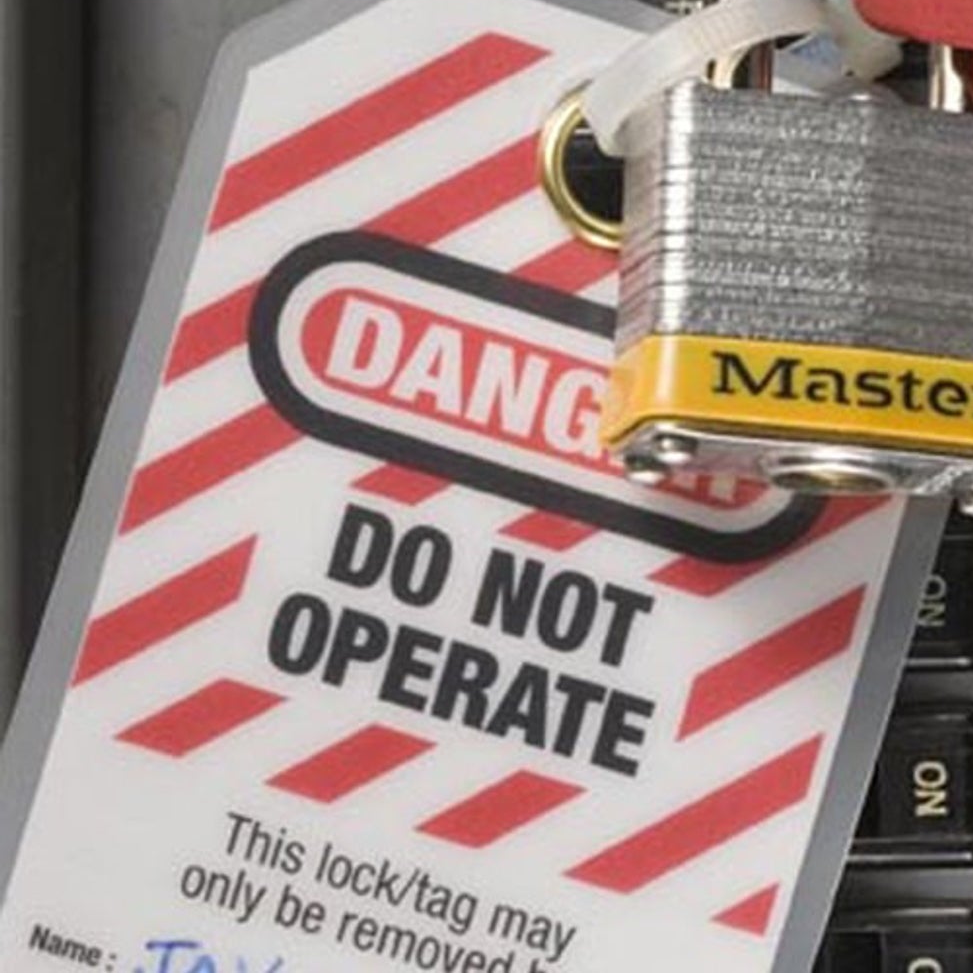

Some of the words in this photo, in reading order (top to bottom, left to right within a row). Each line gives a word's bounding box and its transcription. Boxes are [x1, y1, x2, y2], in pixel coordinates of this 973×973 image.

[327, 502, 453, 608] DO
[471, 548, 656, 668] NOT
[268, 592, 656, 778] OPERATE
[914, 761, 948, 817] ON
[180, 863, 266, 924] only
[274, 884, 326, 934] be
[336, 911, 515, 973] removed
[225, 811, 306, 875] This
[314, 842, 479, 936] lock/tag
[487, 903, 578, 964] may
